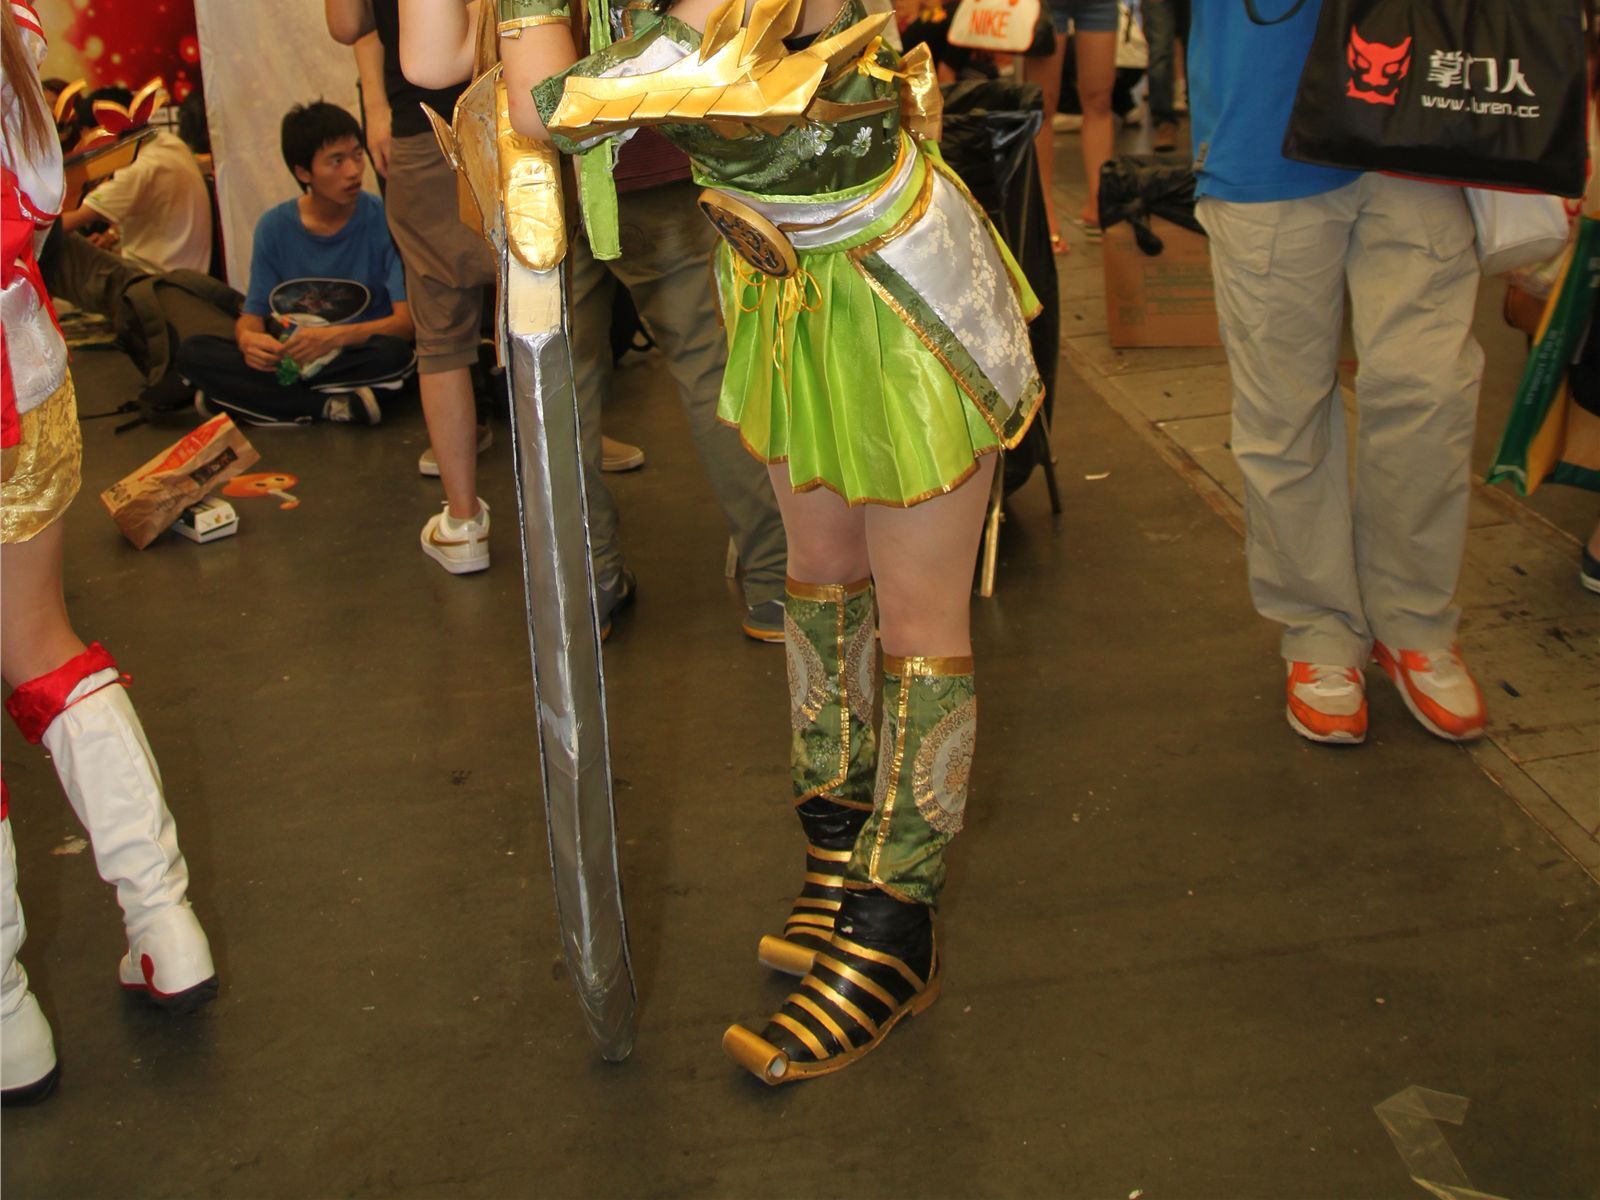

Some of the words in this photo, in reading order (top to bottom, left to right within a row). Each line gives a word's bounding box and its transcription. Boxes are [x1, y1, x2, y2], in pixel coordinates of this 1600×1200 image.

[969, 8, 1010, 39] NIKE
[1427, 49, 1536, 96] 掌门人
